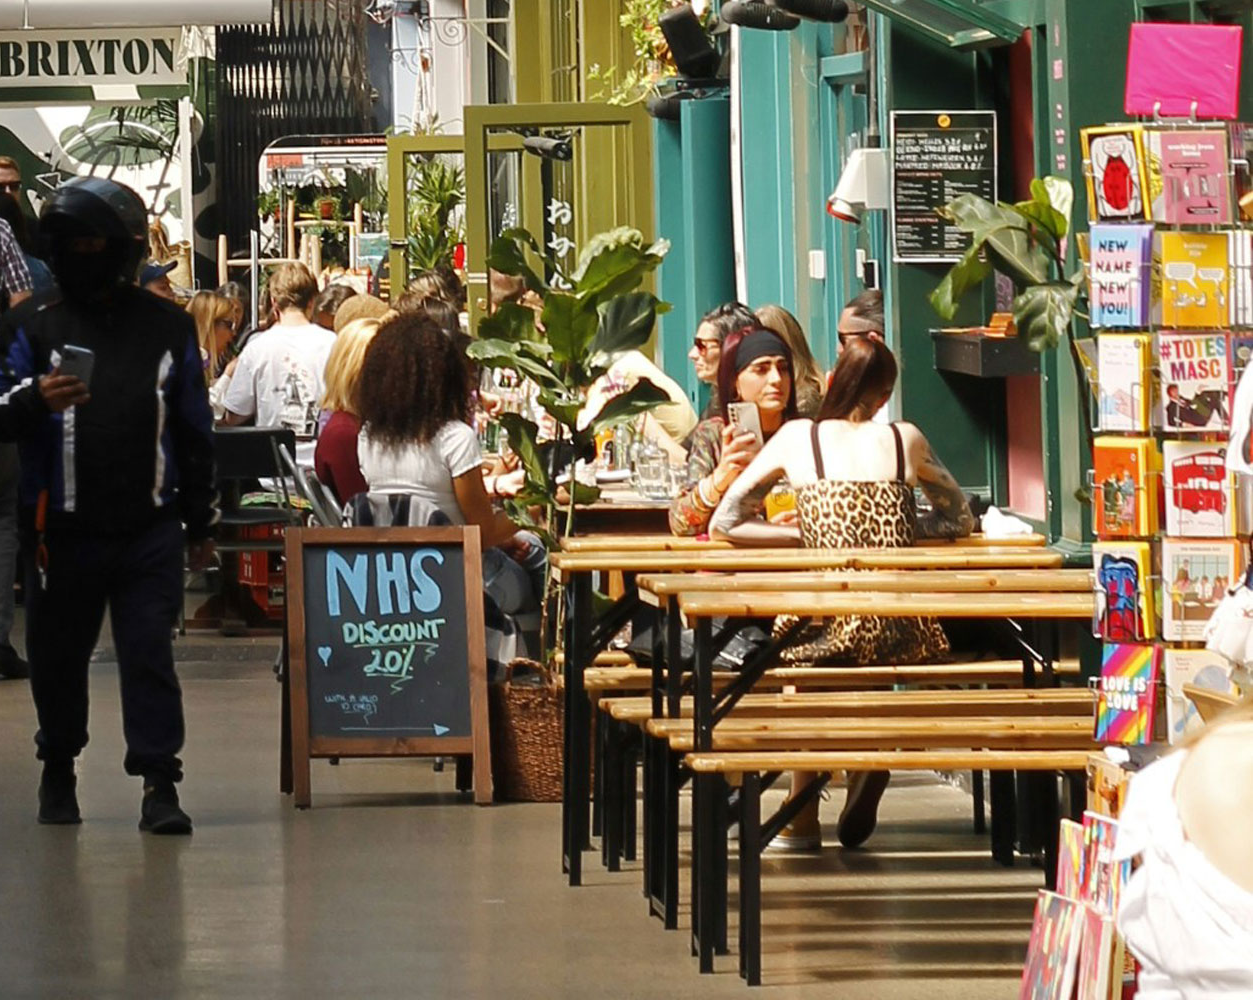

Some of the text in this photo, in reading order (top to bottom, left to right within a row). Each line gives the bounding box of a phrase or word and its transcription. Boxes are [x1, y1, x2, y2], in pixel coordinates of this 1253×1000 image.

[1099, 241, 1128, 253] NEW
[1096, 262, 1131, 273] NAME
[1099, 282, 1127, 294] NEW
[1100, 303, 1128, 315] YOU!
[1159, 336, 1225, 360] #TOTES
[1170, 360, 1221, 381] MASC
[326, 548, 444, 617] NHS
[342, 618, 446, 645] DISCOUNT
[363, 645, 415, 677] 20%
[1102, 677, 1146, 692] LOVE IS
[1106, 694, 1138, 711] LOVE
